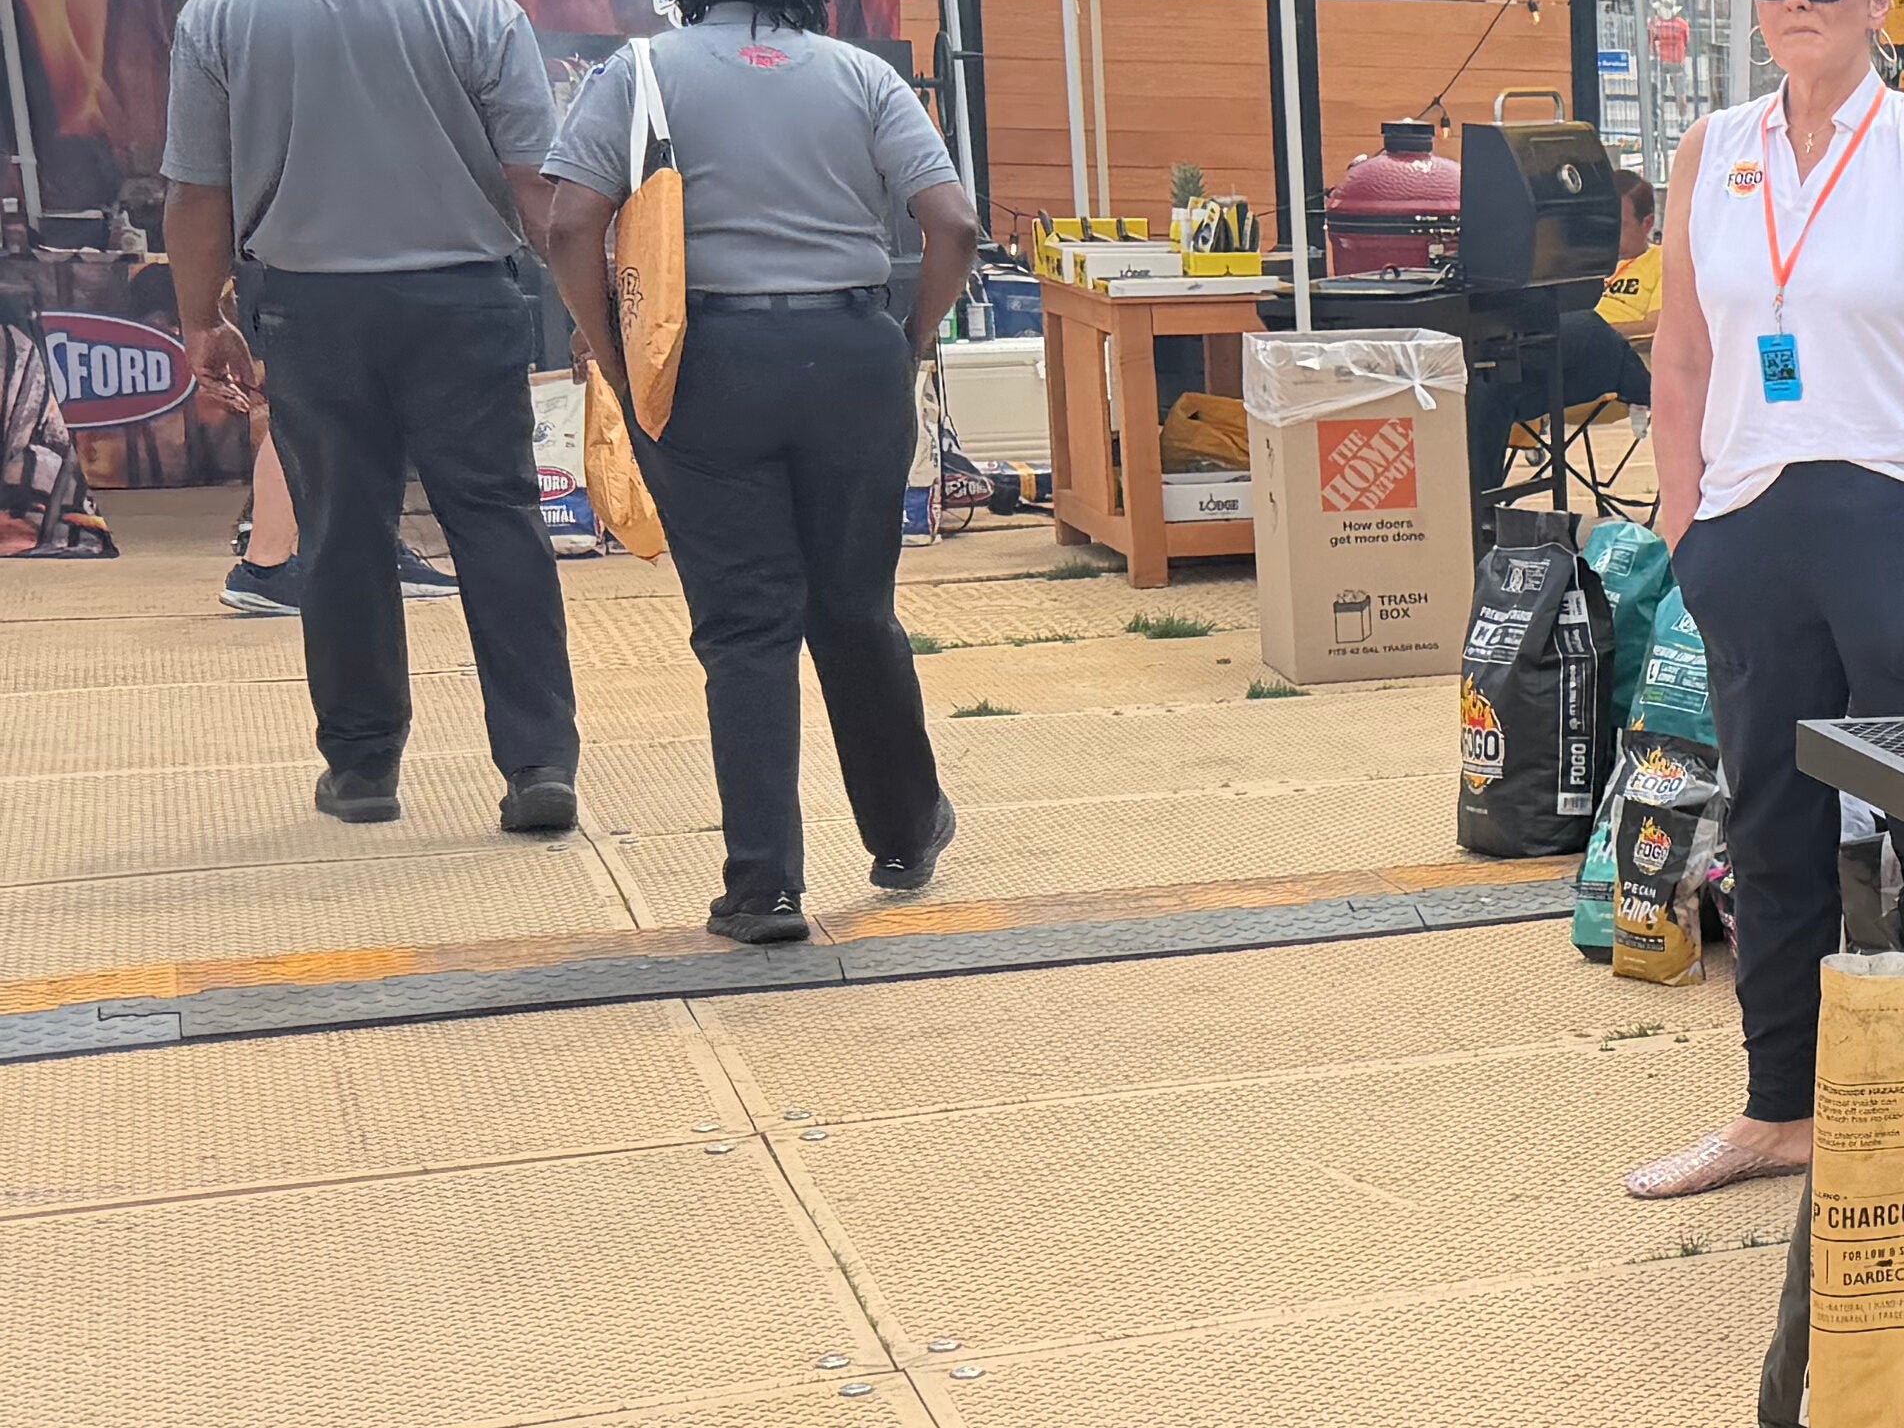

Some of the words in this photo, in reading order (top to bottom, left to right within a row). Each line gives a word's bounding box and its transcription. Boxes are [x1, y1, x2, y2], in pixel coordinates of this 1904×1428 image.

[1727, 170, 1763, 187] FOGO
[1328, 429, 1368, 466] THE
[1322, 418, 1414, 512] HOME
[1358, 450, 1415, 510] DEPOT
[1199, 493, 1240, 512] LODGE
[1342, 521, 1372, 532] How
[1376, 519, 1413, 530] doers
[1330, 535, 1351, 548] get
[1354, 533, 1389, 544] more
[1392, 531, 1426, 542] done
[1376, 592, 1429, 607] TRASH
[1376, 606, 1410, 621] BOX
[1569, 742, 1587, 786] FOGO
[1842, 1250, 1862, 1262] FOR
[1865, 1247, 1885, 1260] LOW
